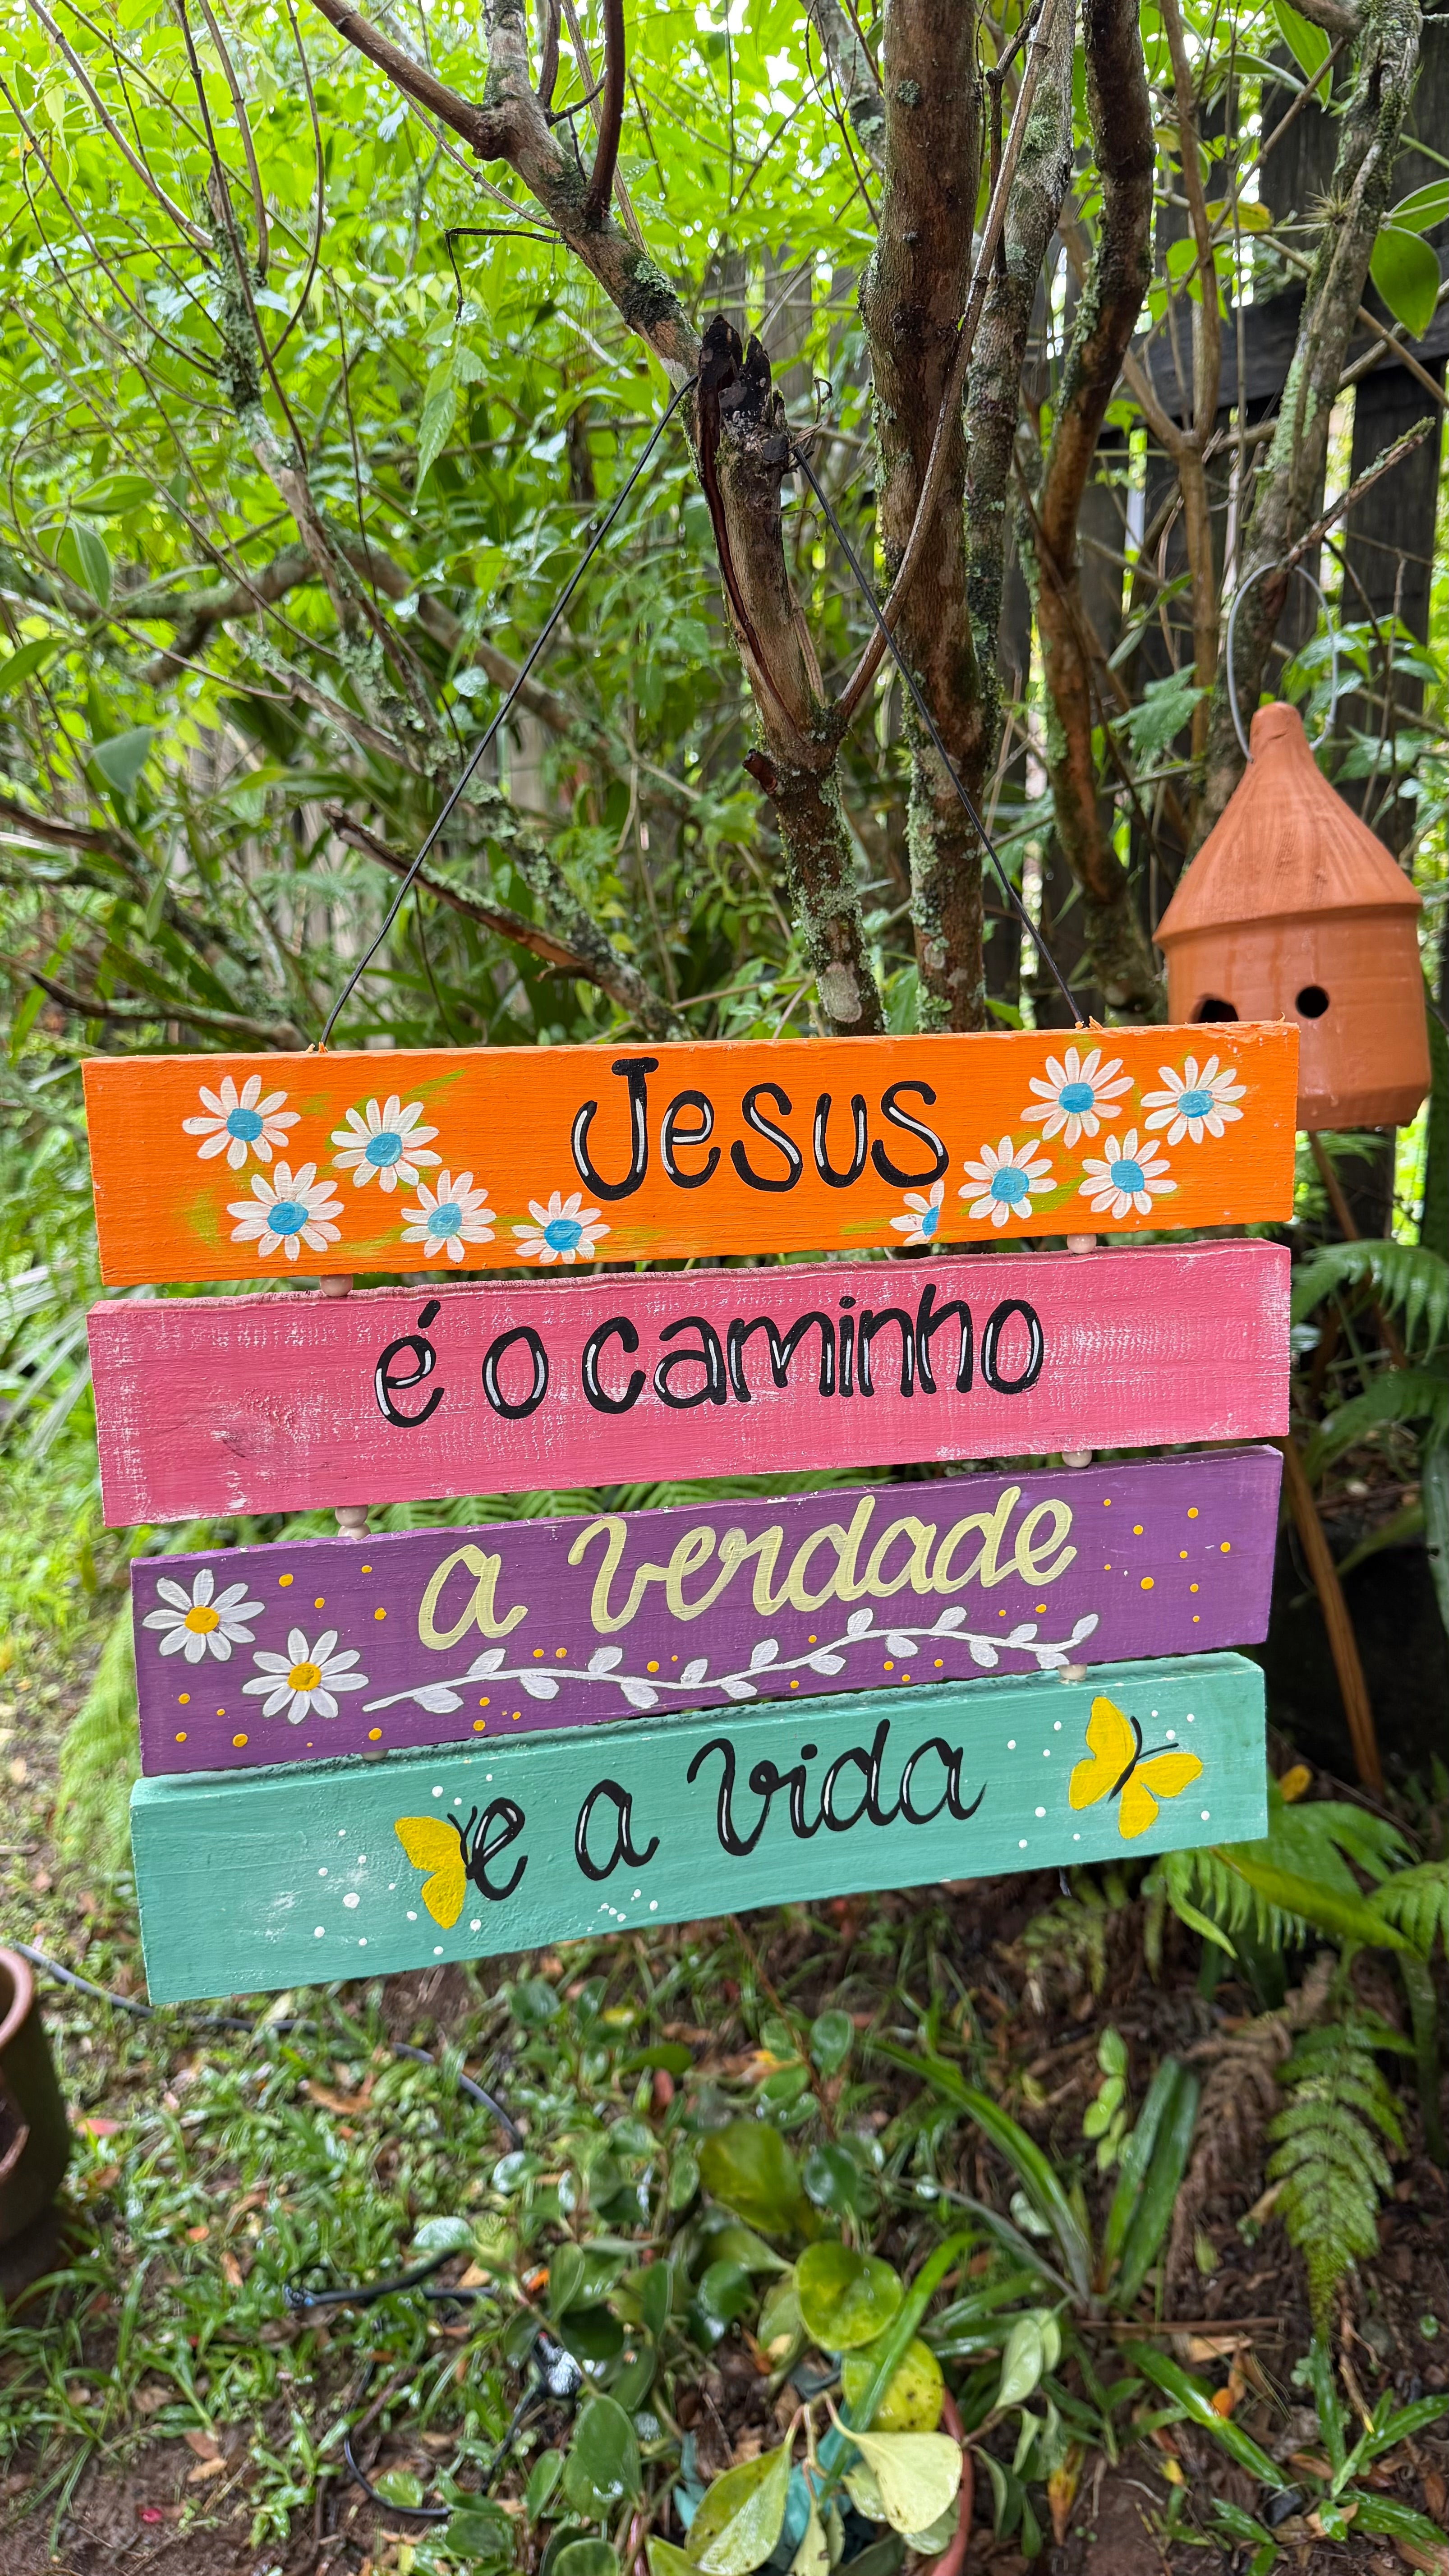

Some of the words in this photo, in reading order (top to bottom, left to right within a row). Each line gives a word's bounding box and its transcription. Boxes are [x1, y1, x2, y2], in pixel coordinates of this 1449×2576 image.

[571, 1057, 949, 1201] Jesus
[375, 1299, 445, 1428] é
[482, 1326, 549, 1420] o
[582, 1283, 1044, 1414] caminho
[419, 1544, 529, 1650] a
[471, 1797, 529, 1901] e
[574, 1778, 660, 1881] a
